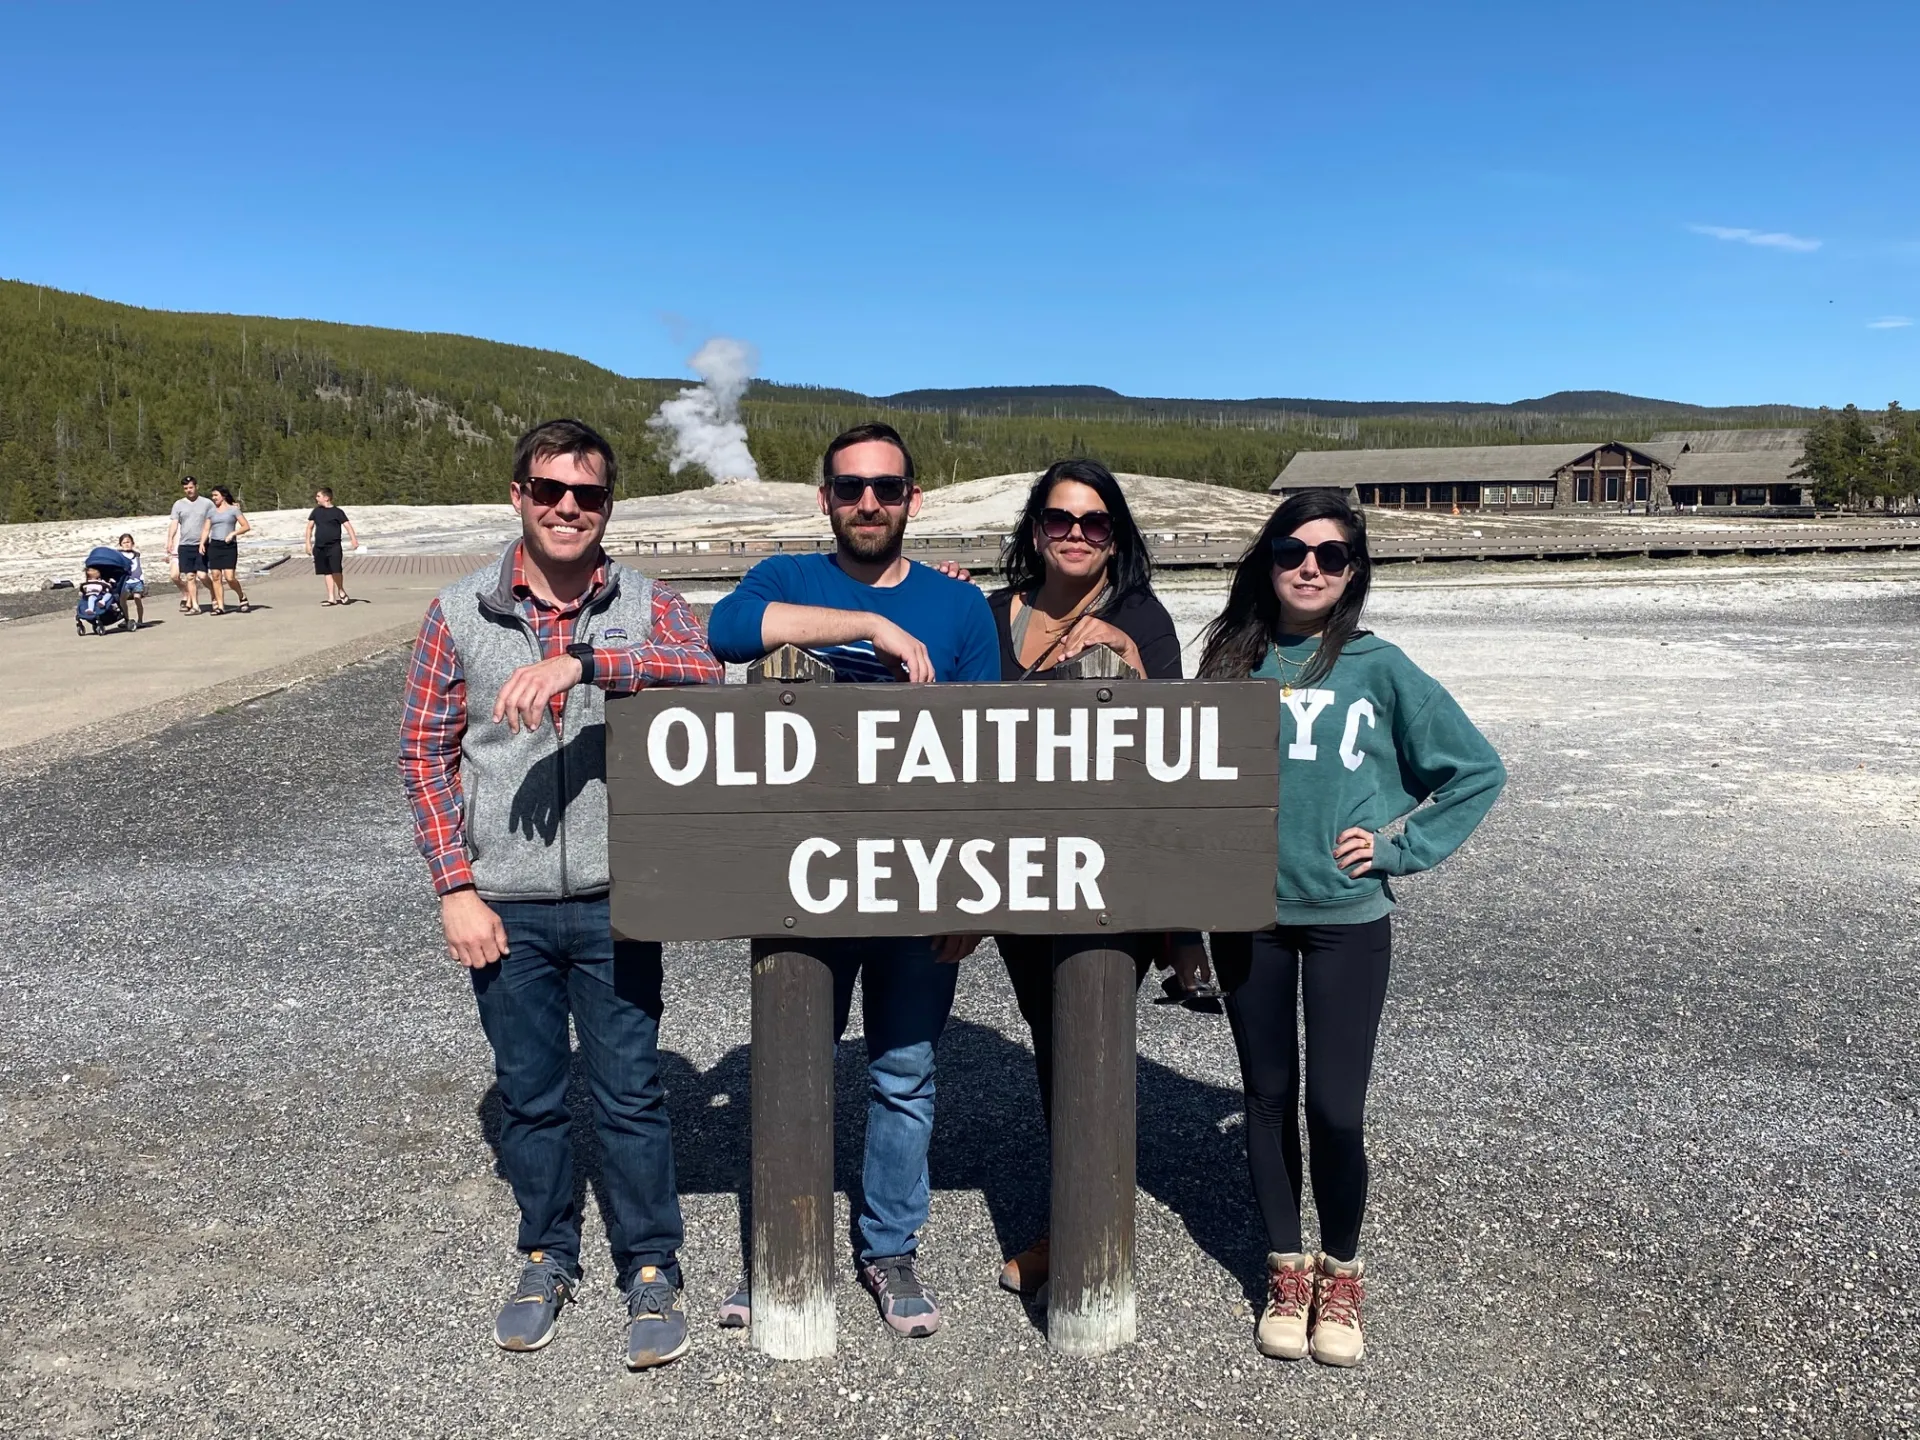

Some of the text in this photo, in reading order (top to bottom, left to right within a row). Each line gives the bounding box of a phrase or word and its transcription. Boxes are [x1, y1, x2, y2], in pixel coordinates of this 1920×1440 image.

[647, 706, 1239, 786] OLD FAITHFUL
[1280, 688, 1375, 772] YC
[788, 836, 1107, 914] GEYSER
